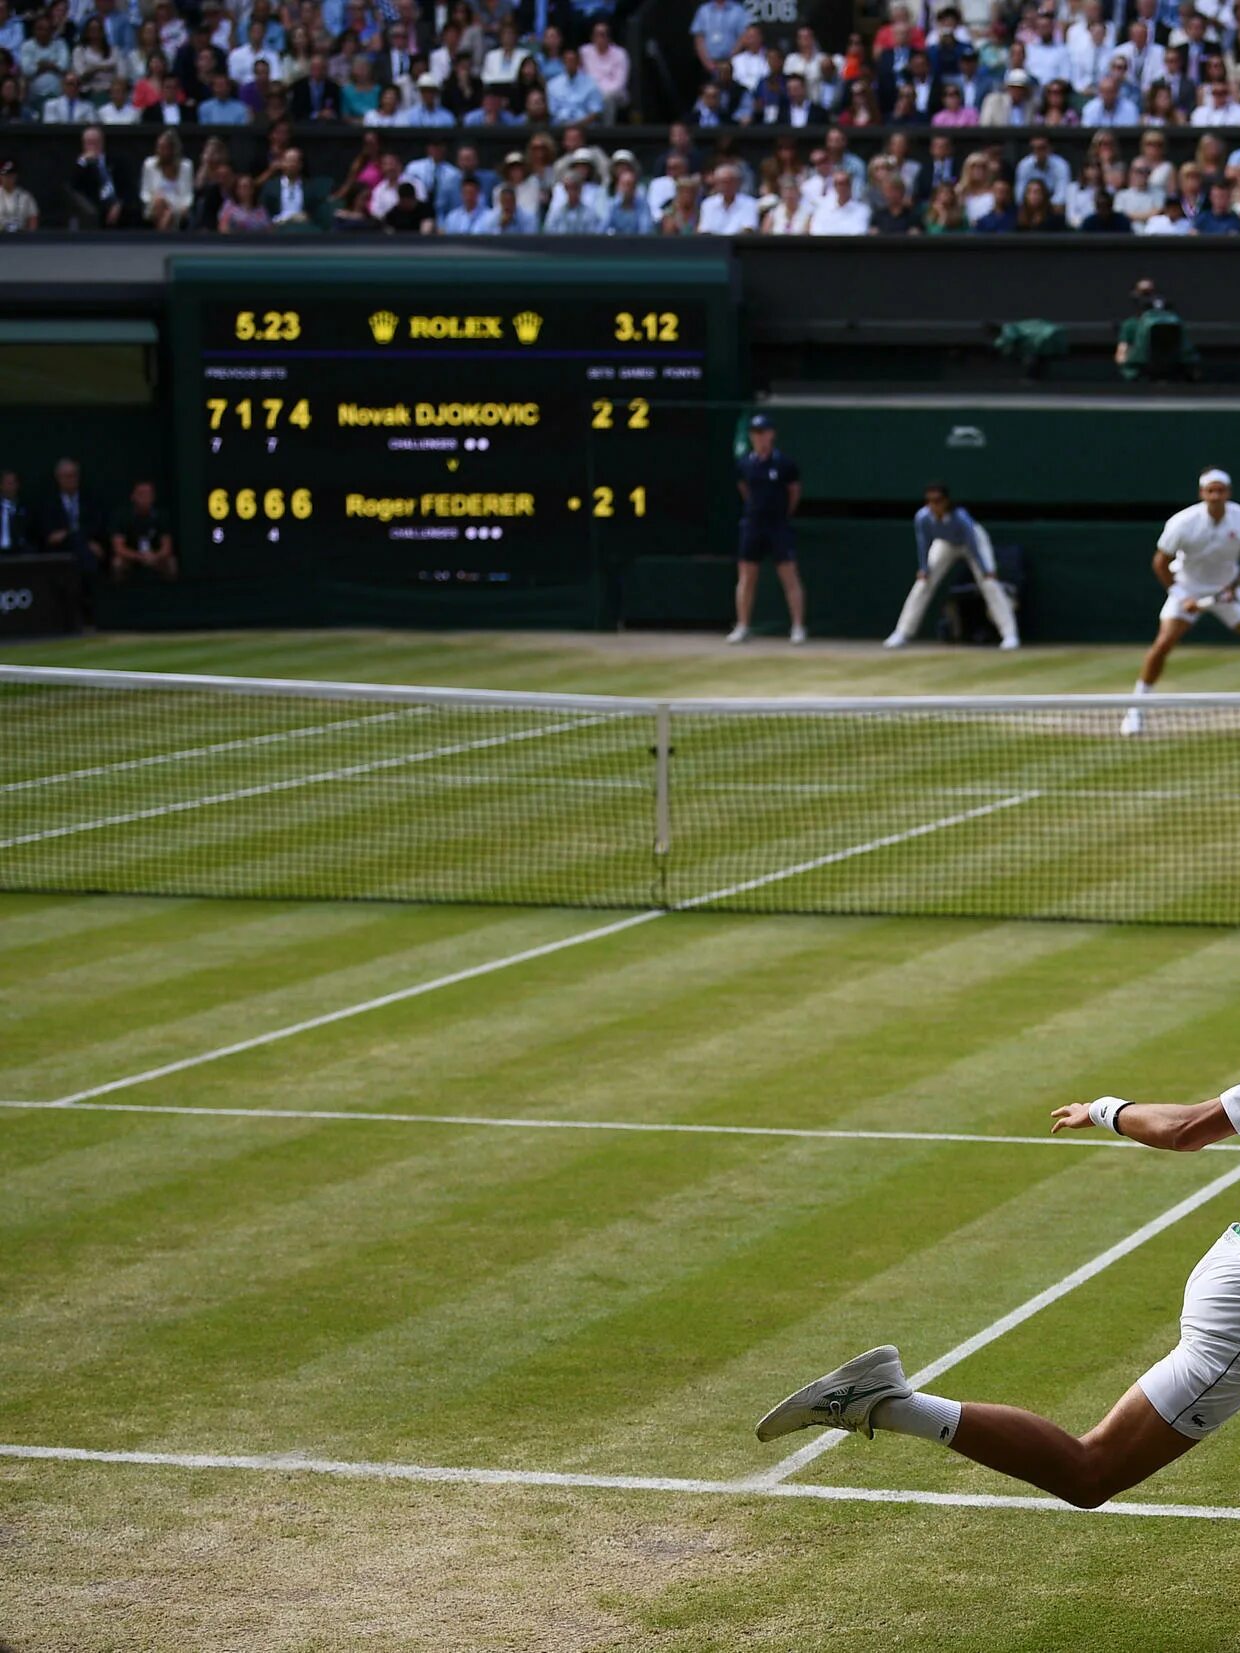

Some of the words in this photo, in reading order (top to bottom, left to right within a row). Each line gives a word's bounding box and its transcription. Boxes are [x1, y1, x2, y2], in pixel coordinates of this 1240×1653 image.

[236, 312, 300, 340] 5.23
[410, 317, 502, 339] ROLEX
[615, 313, 678, 340] 3.12
[208, 399, 228, 428] 7
[236, 399, 252, 428] 1
[263, 399, 283, 428] 7
[290, 399, 311, 428] 4
[338, 403, 411, 426] Novak
[415, 403, 539, 426] DJOKOVIC
[592, 400, 613, 428] 2
[628, 398, 649, 428] 2
[208, 488, 229, 519] 6
[236, 488, 257, 519] 6
[264, 488, 285, 519] 6
[291, 488, 312, 519] 6
[346, 494, 415, 522] Roger
[421, 494, 534, 516] FEDERER
[593, 487, 613, 516] 2
[630, 487, 646, 516] 1
